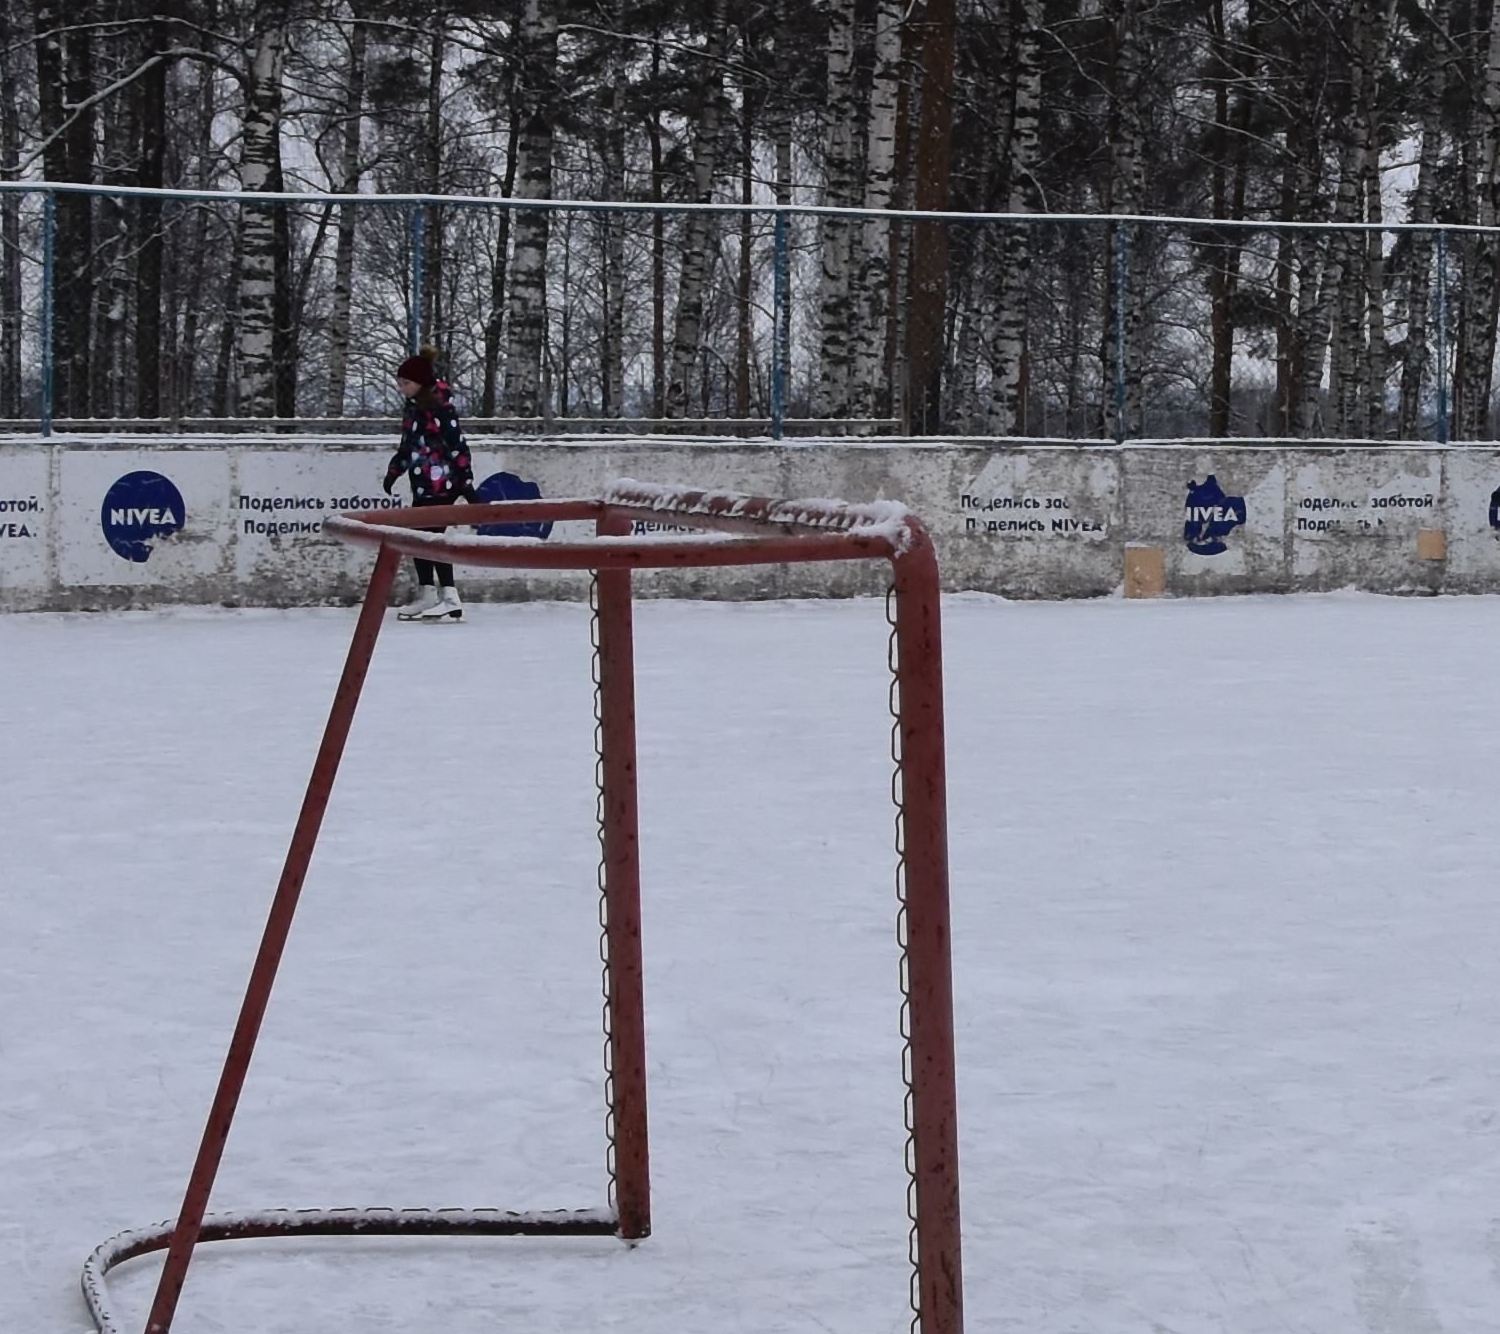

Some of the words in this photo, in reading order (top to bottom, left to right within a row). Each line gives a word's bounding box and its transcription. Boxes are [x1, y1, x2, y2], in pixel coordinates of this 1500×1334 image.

[239, 495, 325, 511] Поделись
[330, 494, 408, 510] заботой.
[111, 507, 177, 526] NIVEA
[244, 520, 321, 536] Поделис
